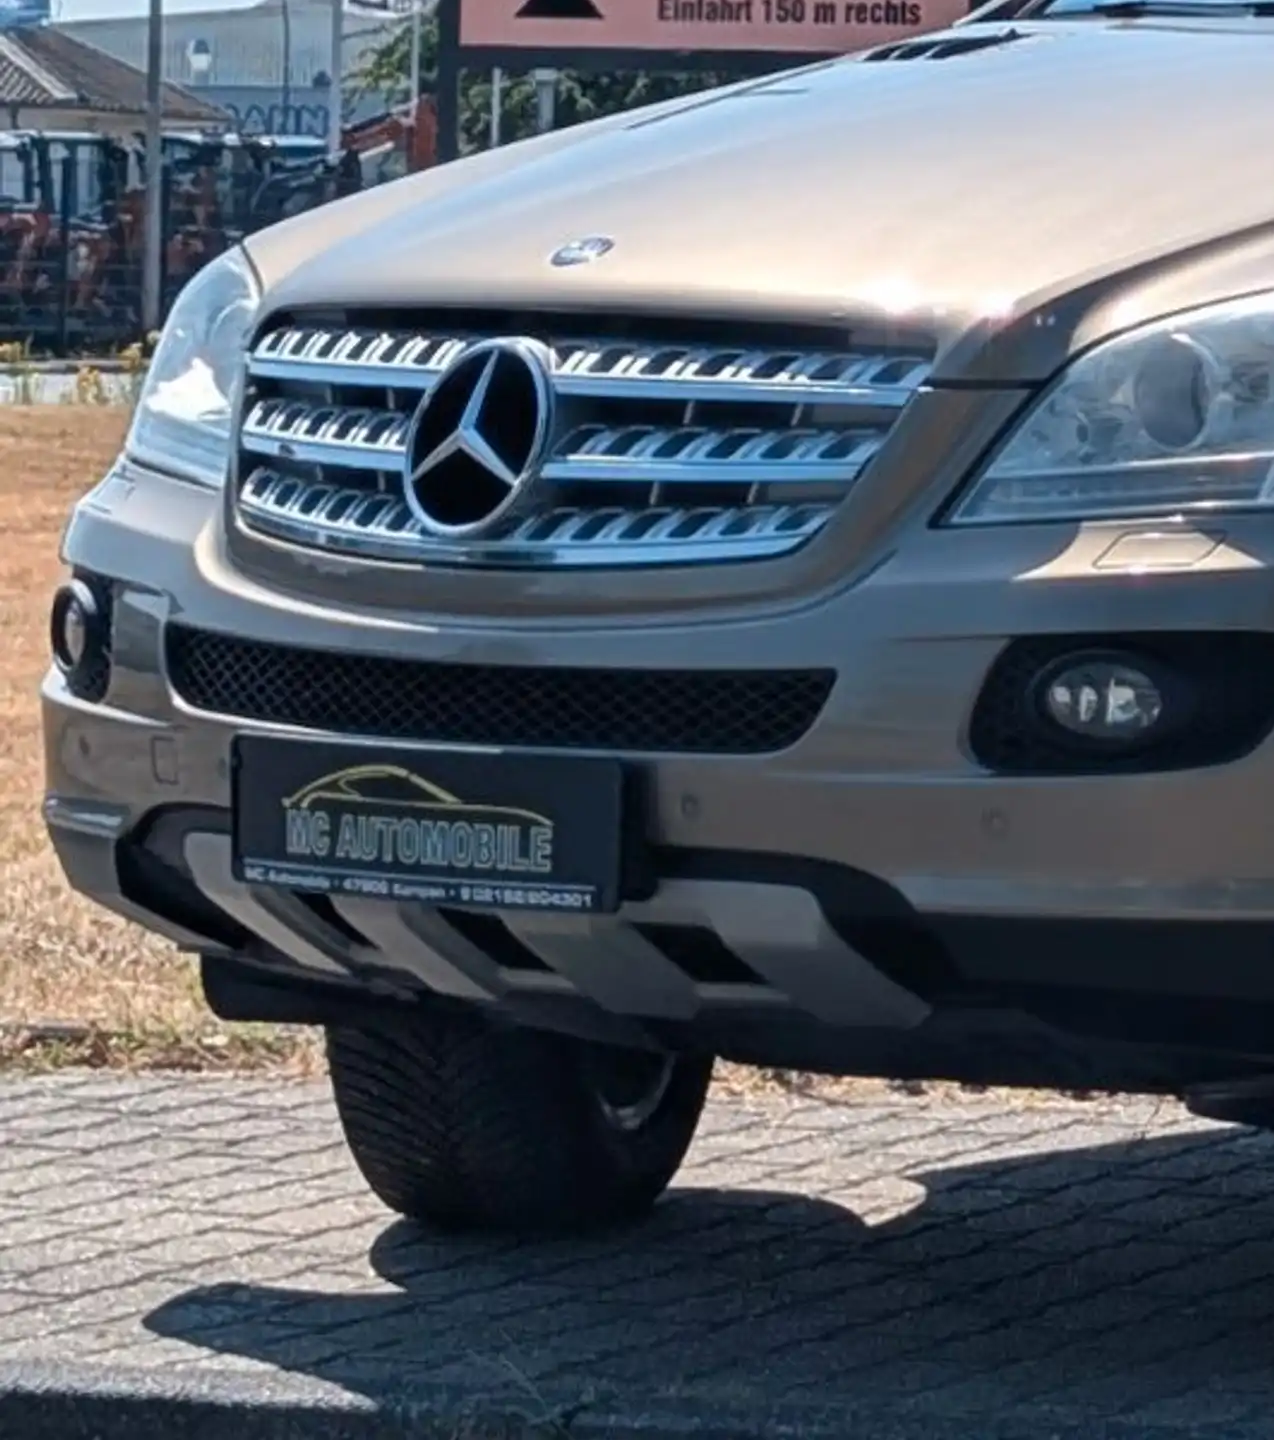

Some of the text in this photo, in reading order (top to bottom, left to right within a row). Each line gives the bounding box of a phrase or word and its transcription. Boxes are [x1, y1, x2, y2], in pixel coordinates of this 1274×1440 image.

[813, 0, 836, 24] m
[286, 809, 553, 874] MC AUTOMOBILE
